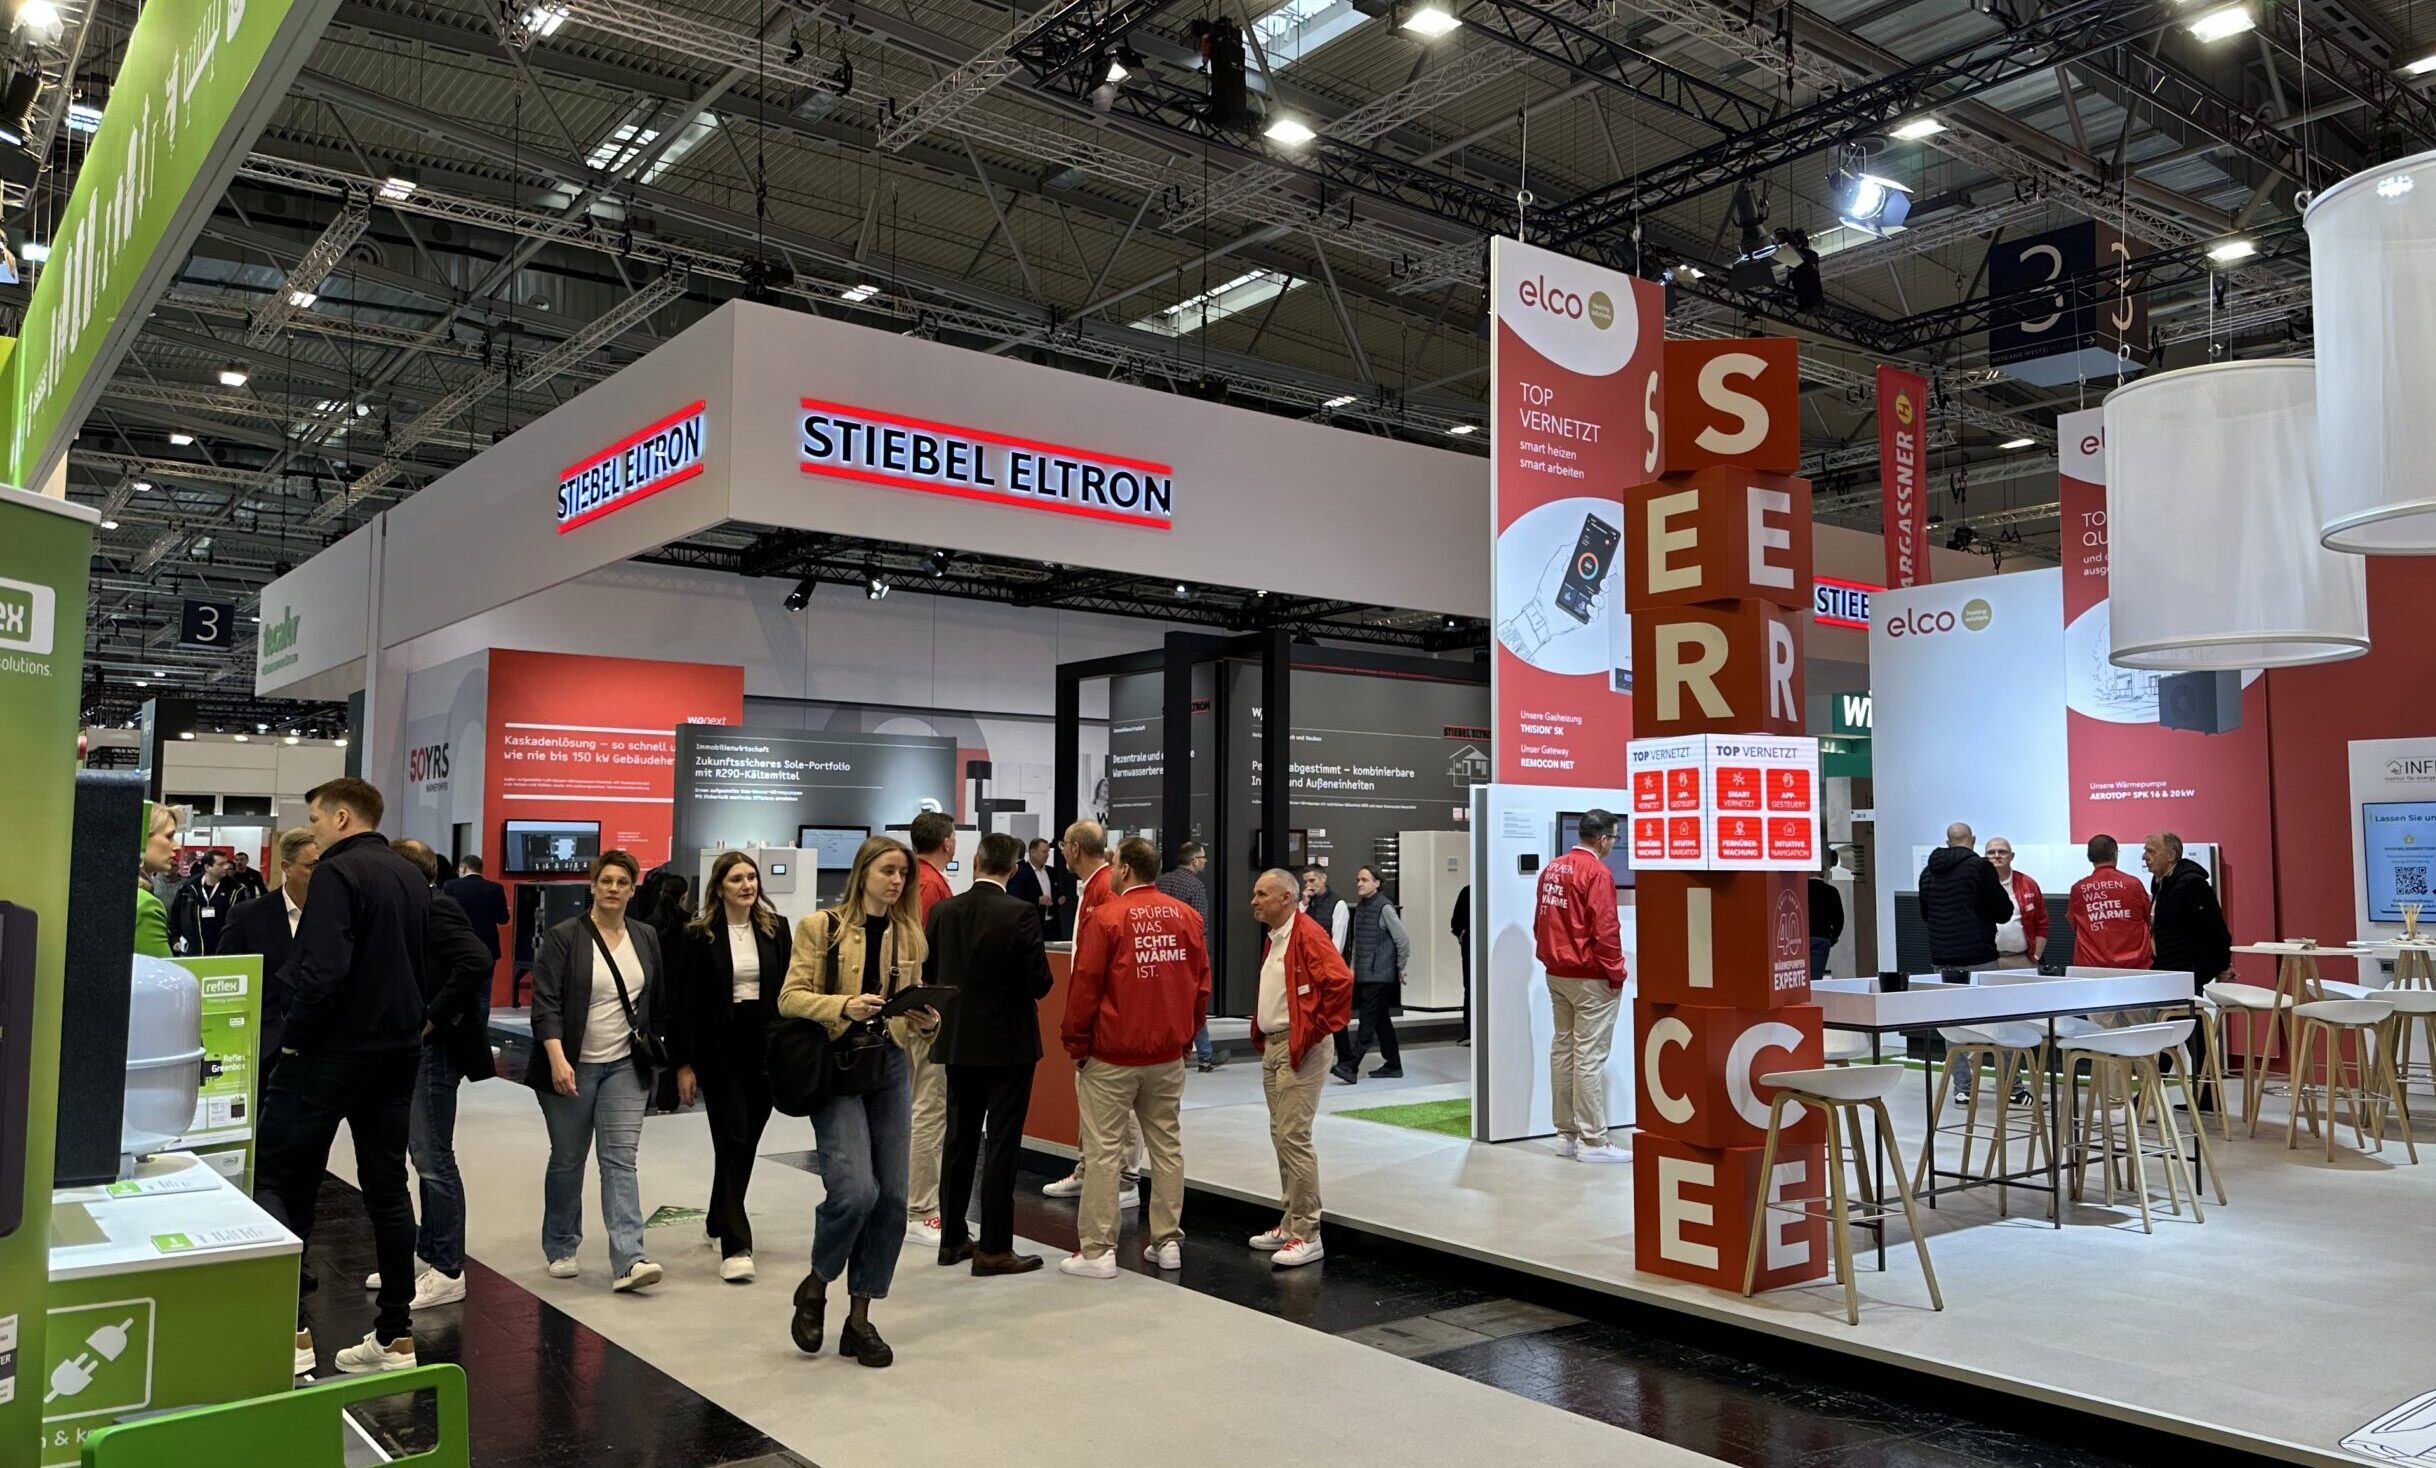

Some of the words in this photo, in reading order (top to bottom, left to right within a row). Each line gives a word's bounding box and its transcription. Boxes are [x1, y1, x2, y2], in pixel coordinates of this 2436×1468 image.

[2019, 244, 2064, 333] 3
[1519, 274, 1583, 320] elco
[1519, 382, 1554, 407] TOP
[1519, 407, 1602, 444] VERNETZT
[1520, 440, 1546, 454] smart
[1547, 442, 1577, 461] heizen
[557, 457, 620, 519] STIEBEL
[624, 416, 701, 490] ELTRON
[803, 415, 996, 487] STIEBEL
[1009, 451, 1172, 514] ELTRON
[1520, 458, 1546, 473] smart
[1547, 462, 1585, 480] arbeiten
[2083, 552, 2102, 564] und
[195, 605, 220, 642] 3
[1887, 607, 1956, 638] elco
[0, 655, 53, 678] olutions.
[1520, 710, 1544, 721] Unsere
[1544, 711, 1583, 726] Gasheizung
[1553, 726, 1565, 736] SK
[504, 735, 597, 751] Kaskadenlösung
[611, 741, 625, 750] so
[627, 739, 667, 752] schnell
[1520, 744, 1541, 755] Unser
[1541, 745, 1569, 758] Gateway
[504, 751, 523, 761] wie
[527, 751, 546, 762] nie
[550, 751, 569, 762] bis
[571, 752, 592, 763] 150
[595, 752, 610, 764] kW
[612, 753, 675, 767] Gebäudehe
[1112, 752, 1147, 764] Dezentrale
[1147, 750, 1161, 762] und
[1633, 751, 1650, 762] TOP
[1650, 746, 1691, 761] VERNETZT
[1716, 745, 1741, 757] TOP
[1742, 746, 1798, 759] VERNETZT
[409, 742, 450, 783] 50YRS
[695, 756, 782, 769] Zukunftssicheres
[783, 758, 851, 771] Sole-Portfolio
[1520, 757, 1560, 769] REMOCON
[1560, 760, 1575, 770] NET
[695, 768, 713, 779] mit
[715, 768, 801, 781] R290-Kältemittel
[1352, 765, 1415, 778] kombinierbare
[1305, 777, 1375, 791] Außeneinheiten
[2090, 782, 2114, 790] Unsere
[2115, 780, 2167, 790] Wärmepumpe
[1723, 799, 1755, 807] VERNETZT
[2375, 814, 2406, 822] Lassen
[2408, 814, 2423, 822] Sie
[1774, 840, 1805, 848] INTUITIVE
[1771, 849, 1809, 857] NAVIGATION
[2082, 890, 2108, 903] WAS
[1129, 904, 1184, 920] SPÜREN,
[2086, 899, 2122, 913] ECHTE
[2088, 909, 2132, 922] WÄRME
[1131, 920, 1163, 935] WAS
[1134, 934, 1177, 949] ECHTE
[1135, 946, 1187, 964] WÄRME
[1136, 964, 1160, 979] IST.
[205, 979, 238, 993] reflex
[1774, 969, 1807, 992] EXPERTE
